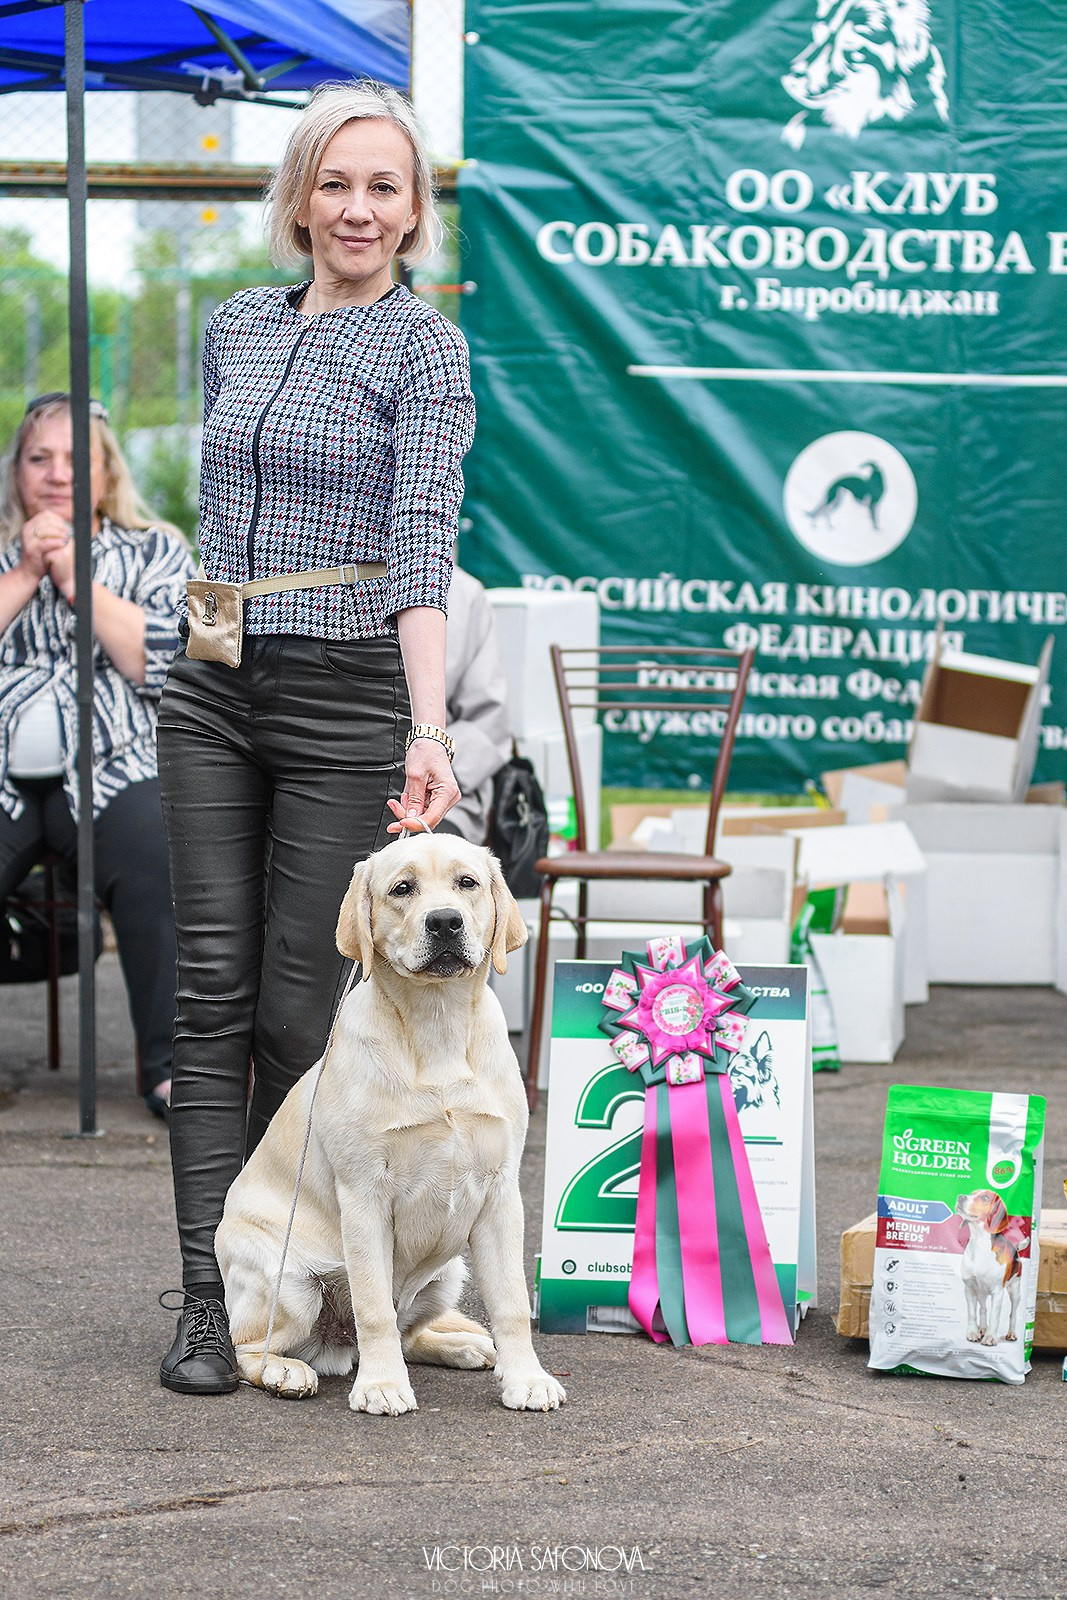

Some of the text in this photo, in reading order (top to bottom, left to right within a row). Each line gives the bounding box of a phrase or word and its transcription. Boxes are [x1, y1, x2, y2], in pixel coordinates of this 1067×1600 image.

[725, 168, 999, 216] ОО «КЛУБ
[535, 220, 1036, 281] СОБАКОВОДСТВА
[719, 277, 1000, 321] г. Биробиджан
[554, 1061, 646, 1233] 2
[906, 1137, 971, 1155] GREEN
[892, 1150, 972, 1171] HOLDER
[887, 1200, 928, 1215] ADULT
[885, 1230, 924, 1243] BREEDS
[886, 1221, 930, 1234] MEDIUM
